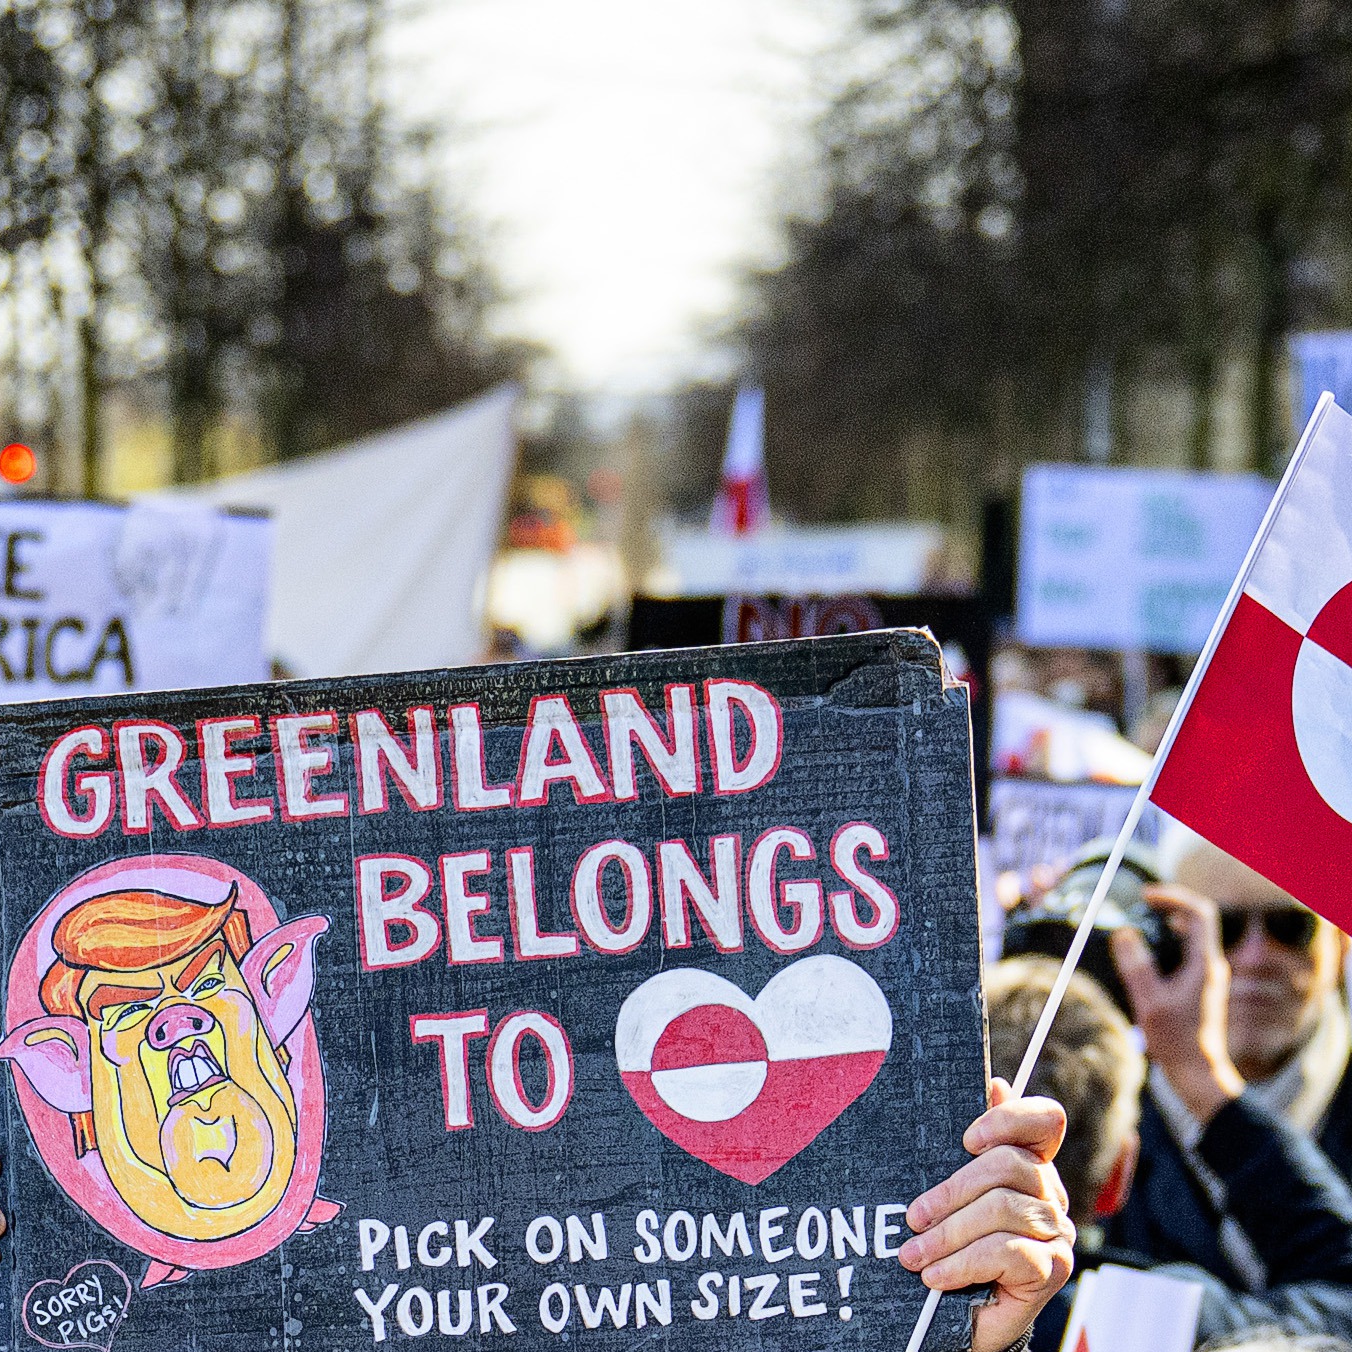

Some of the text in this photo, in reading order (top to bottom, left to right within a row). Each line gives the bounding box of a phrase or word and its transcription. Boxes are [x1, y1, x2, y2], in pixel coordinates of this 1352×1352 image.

[41, 677, 783, 839] GREENLAND
[355, 821, 900, 971] BELONGS
[409, 1008, 575, 1132] TO
[359, 1203, 908, 1271] PICK ON SOMEONE
[33, 1274, 103, 1325] SORRY
[58, 1295, 128, 1344] PIGS!
[354, 1265, 854, 1342] YOUR OWN SIZE!
